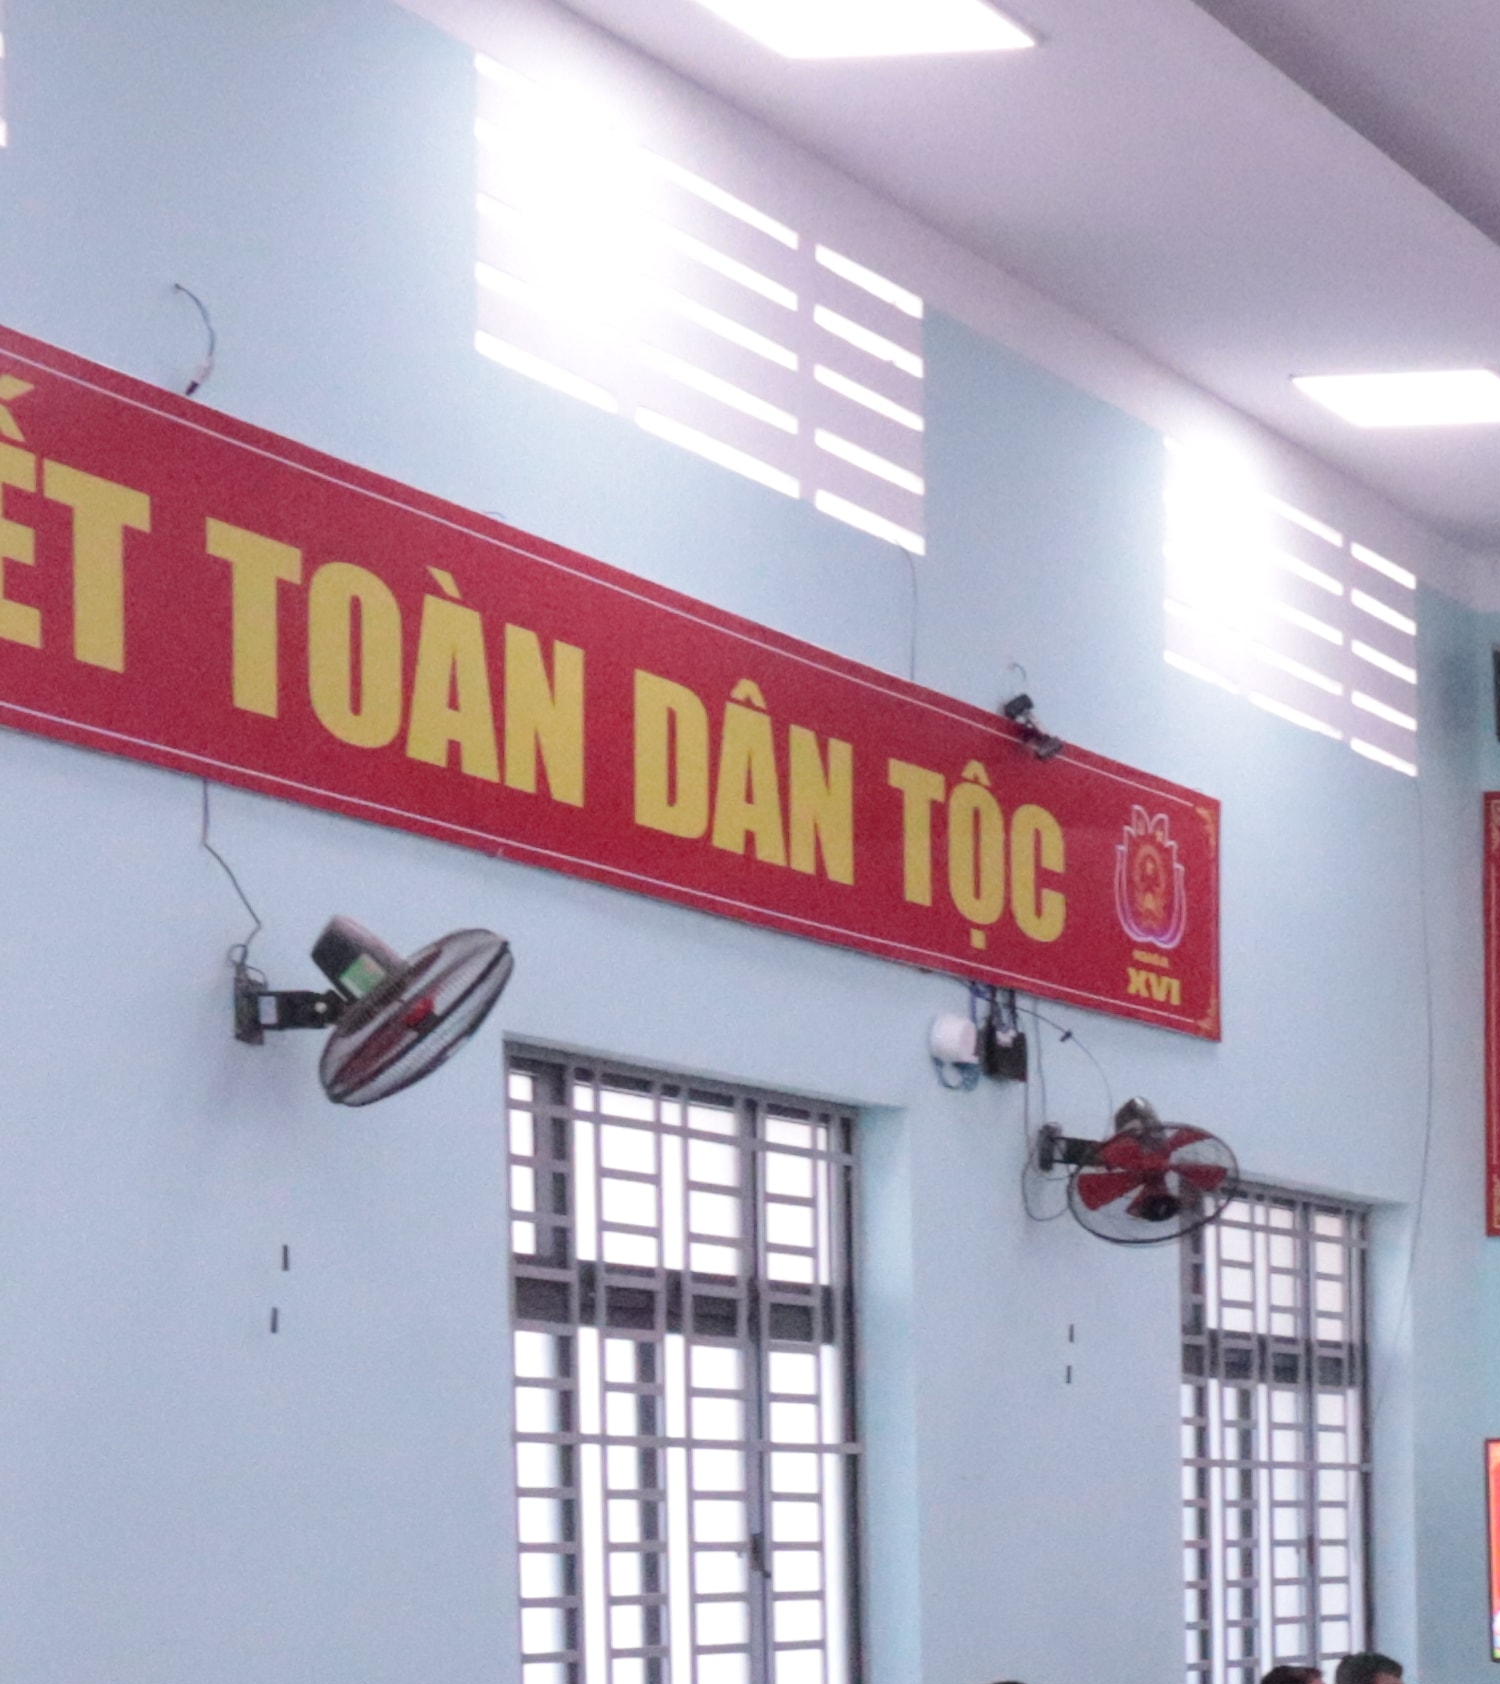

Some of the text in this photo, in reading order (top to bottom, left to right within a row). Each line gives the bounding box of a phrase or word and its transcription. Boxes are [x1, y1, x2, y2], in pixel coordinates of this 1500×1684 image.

[205, 566, 586, 806] TOÀN
[627, 661, 859, 891] DÂN
[883, 759, 1065, 954] TỘC
[1127, 966, 1181, 1006] XVI
